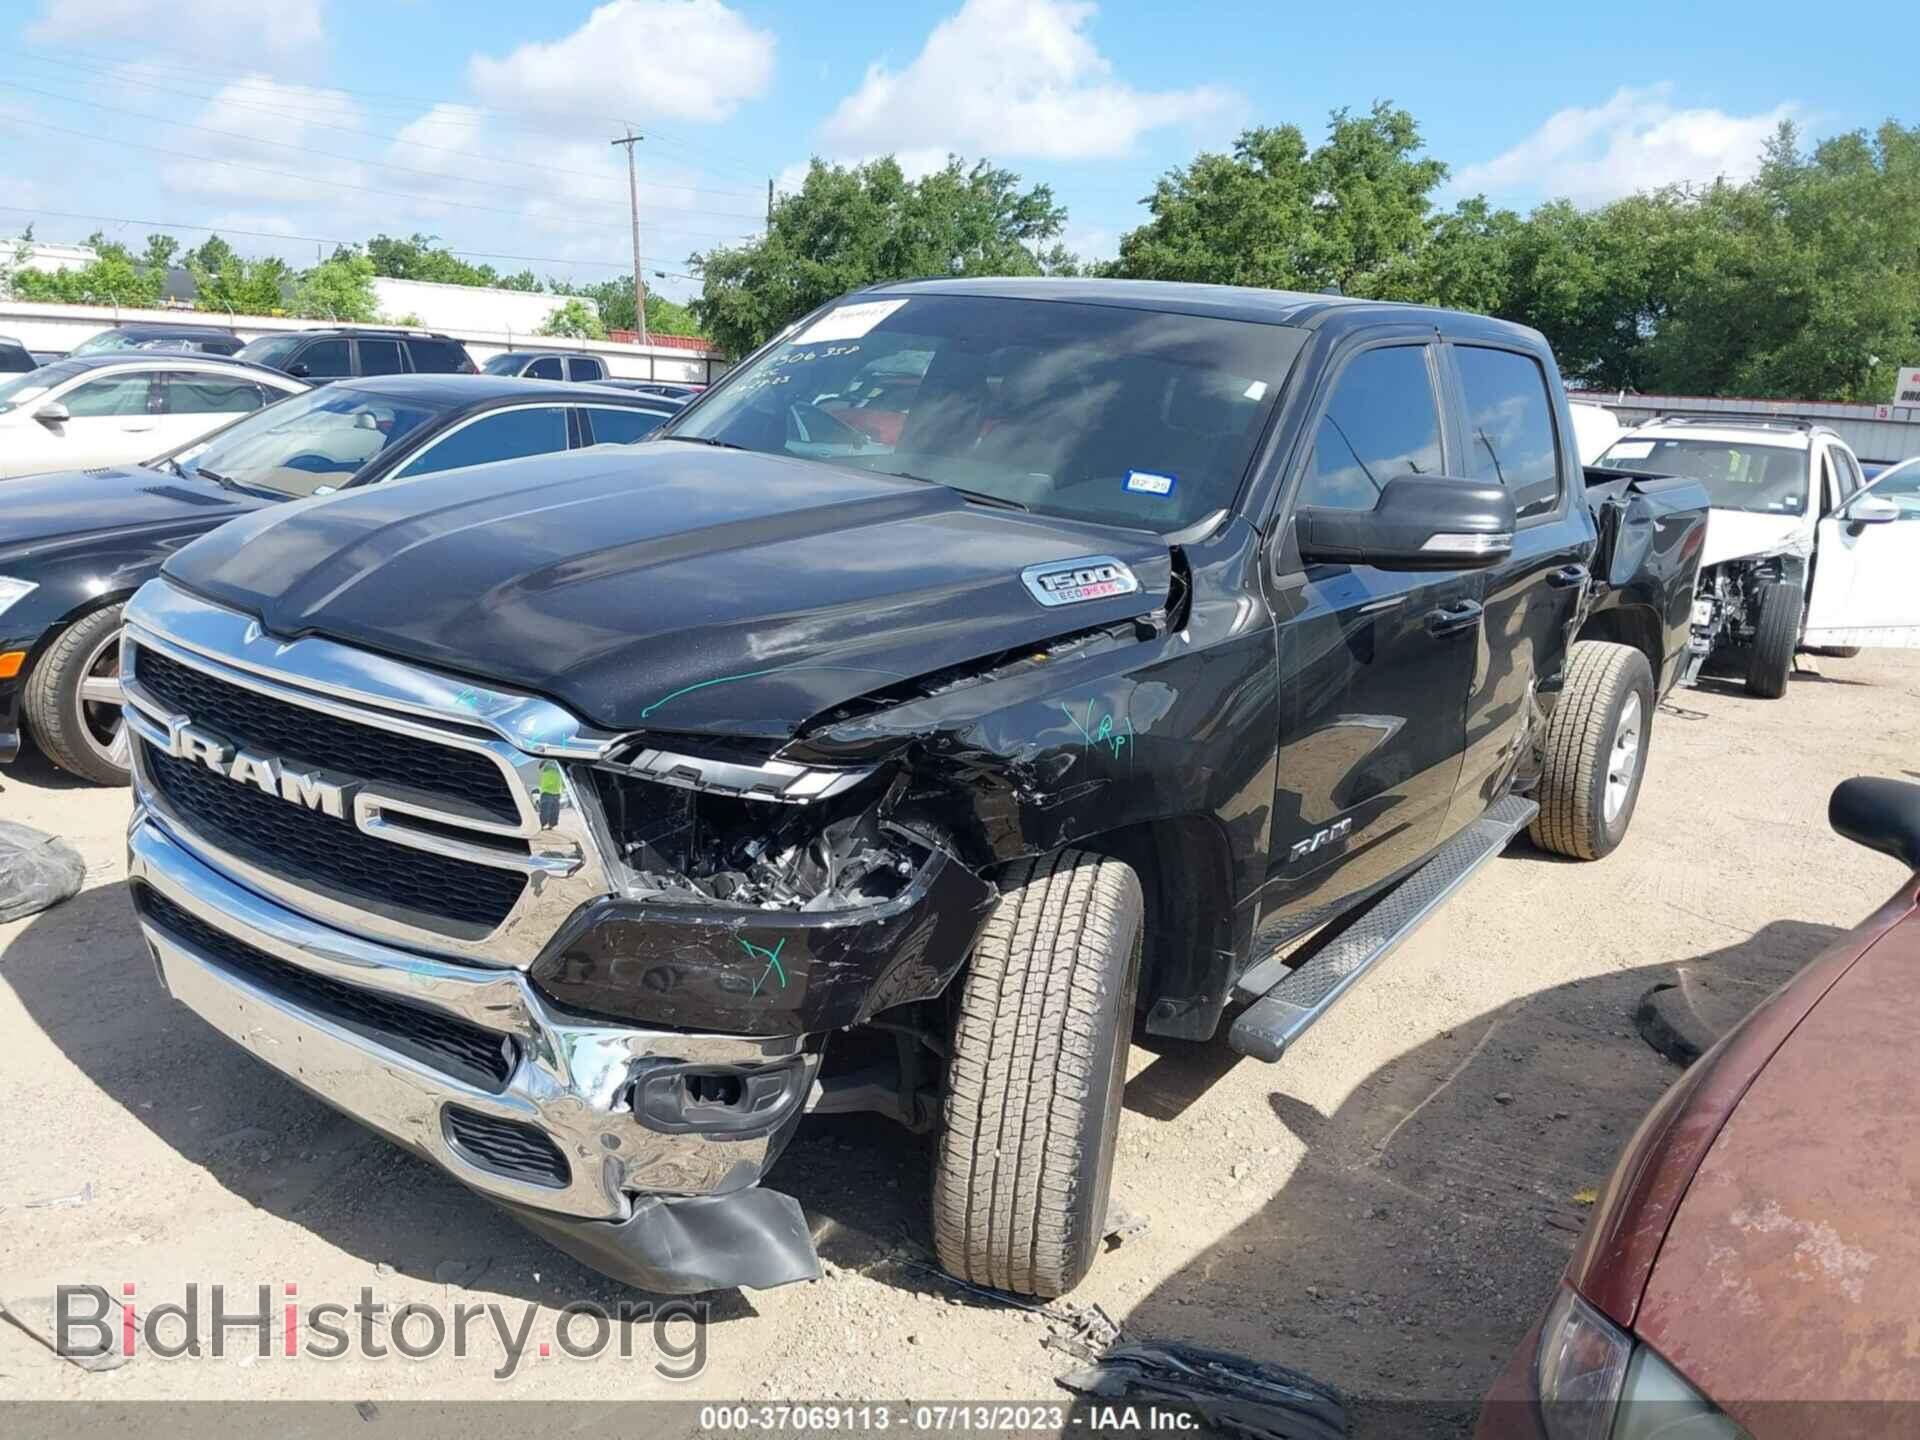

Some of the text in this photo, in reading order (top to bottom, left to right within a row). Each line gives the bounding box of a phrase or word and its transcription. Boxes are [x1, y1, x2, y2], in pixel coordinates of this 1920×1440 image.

[1039, 565, 1117, 591] 1500
[178, 724, 352, 821] RAM
[1290, 817, 1352, 862] RAM
